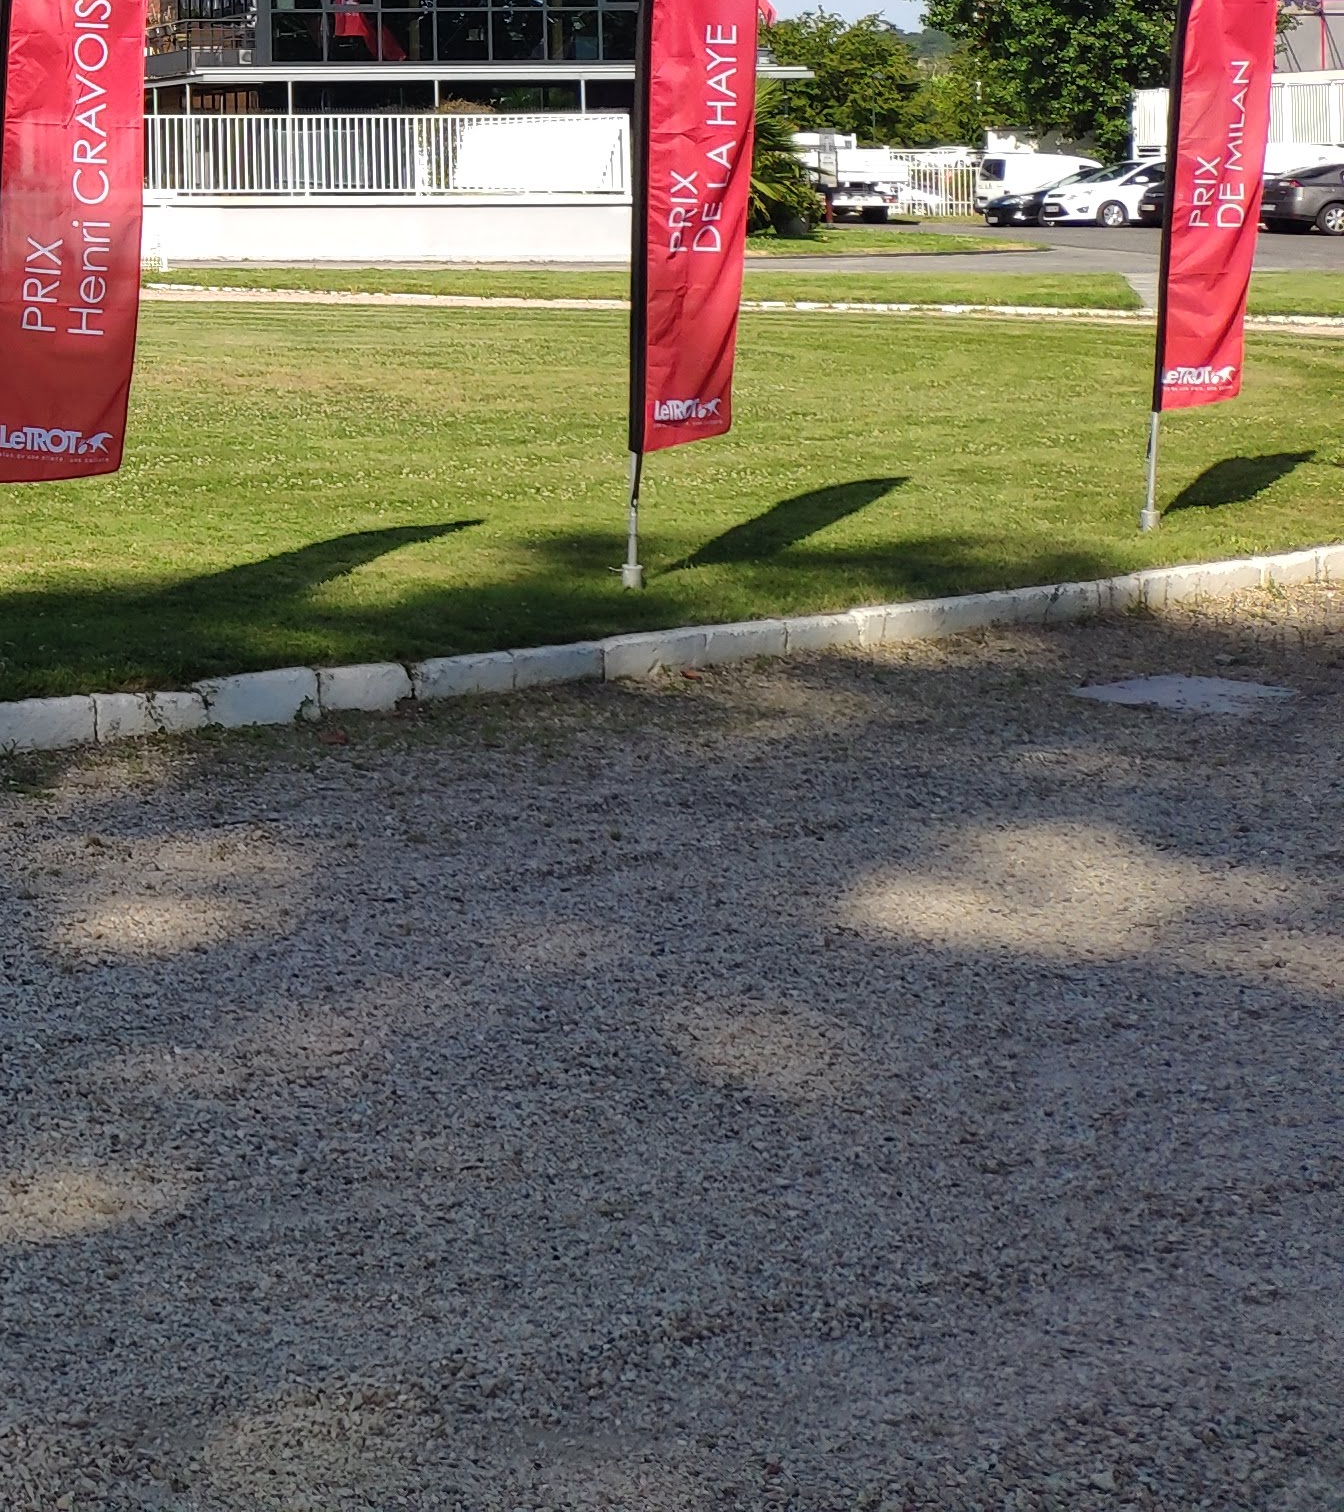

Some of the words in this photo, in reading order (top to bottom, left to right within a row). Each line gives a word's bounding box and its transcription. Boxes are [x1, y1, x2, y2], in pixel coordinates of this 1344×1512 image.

[705, 24, 737, 125] HAYE
[1224, 60, 1250, 171] MILAN
[705, 140, 737, 188] LA
[1188, 156, 1221, 227] PRIX
[668, 170, 698, 252] PRIX
[692, 201, 723, 252] DE
[1216, 182, 1245, 228] DE
[21, 235, 64, 333] PRIX
[66, 220, 111, 336] Henri
[0, 425, 82, 453] LeTROT
